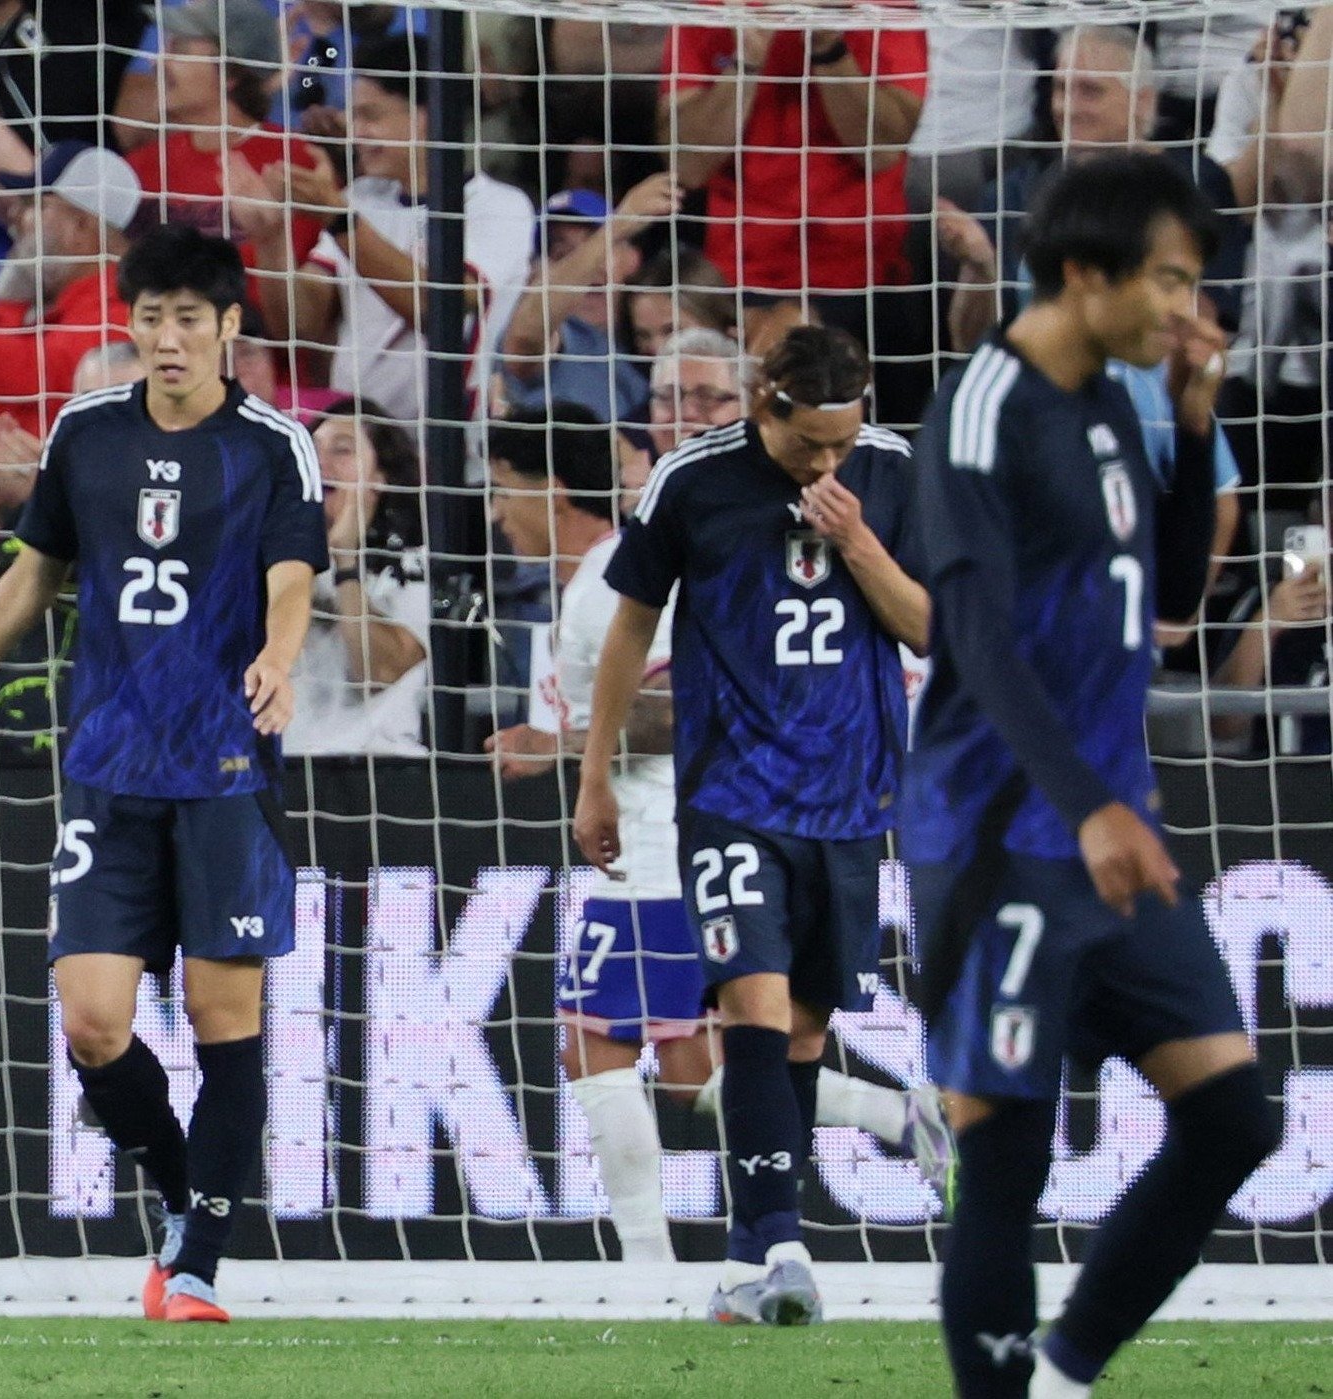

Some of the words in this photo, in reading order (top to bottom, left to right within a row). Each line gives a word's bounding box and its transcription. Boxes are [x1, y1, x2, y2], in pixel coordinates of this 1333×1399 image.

[118, 556, 190, 626] 25
[774, 597, 846, 666] 22
[692, 842, 765, 915] 22
[230, 915, 265, 939] Y-3
[996, 901, 1045, 998] 7
[738, 1151, 792, 1176] Y-3
[189, 1186, 233, 1218] Y-3
